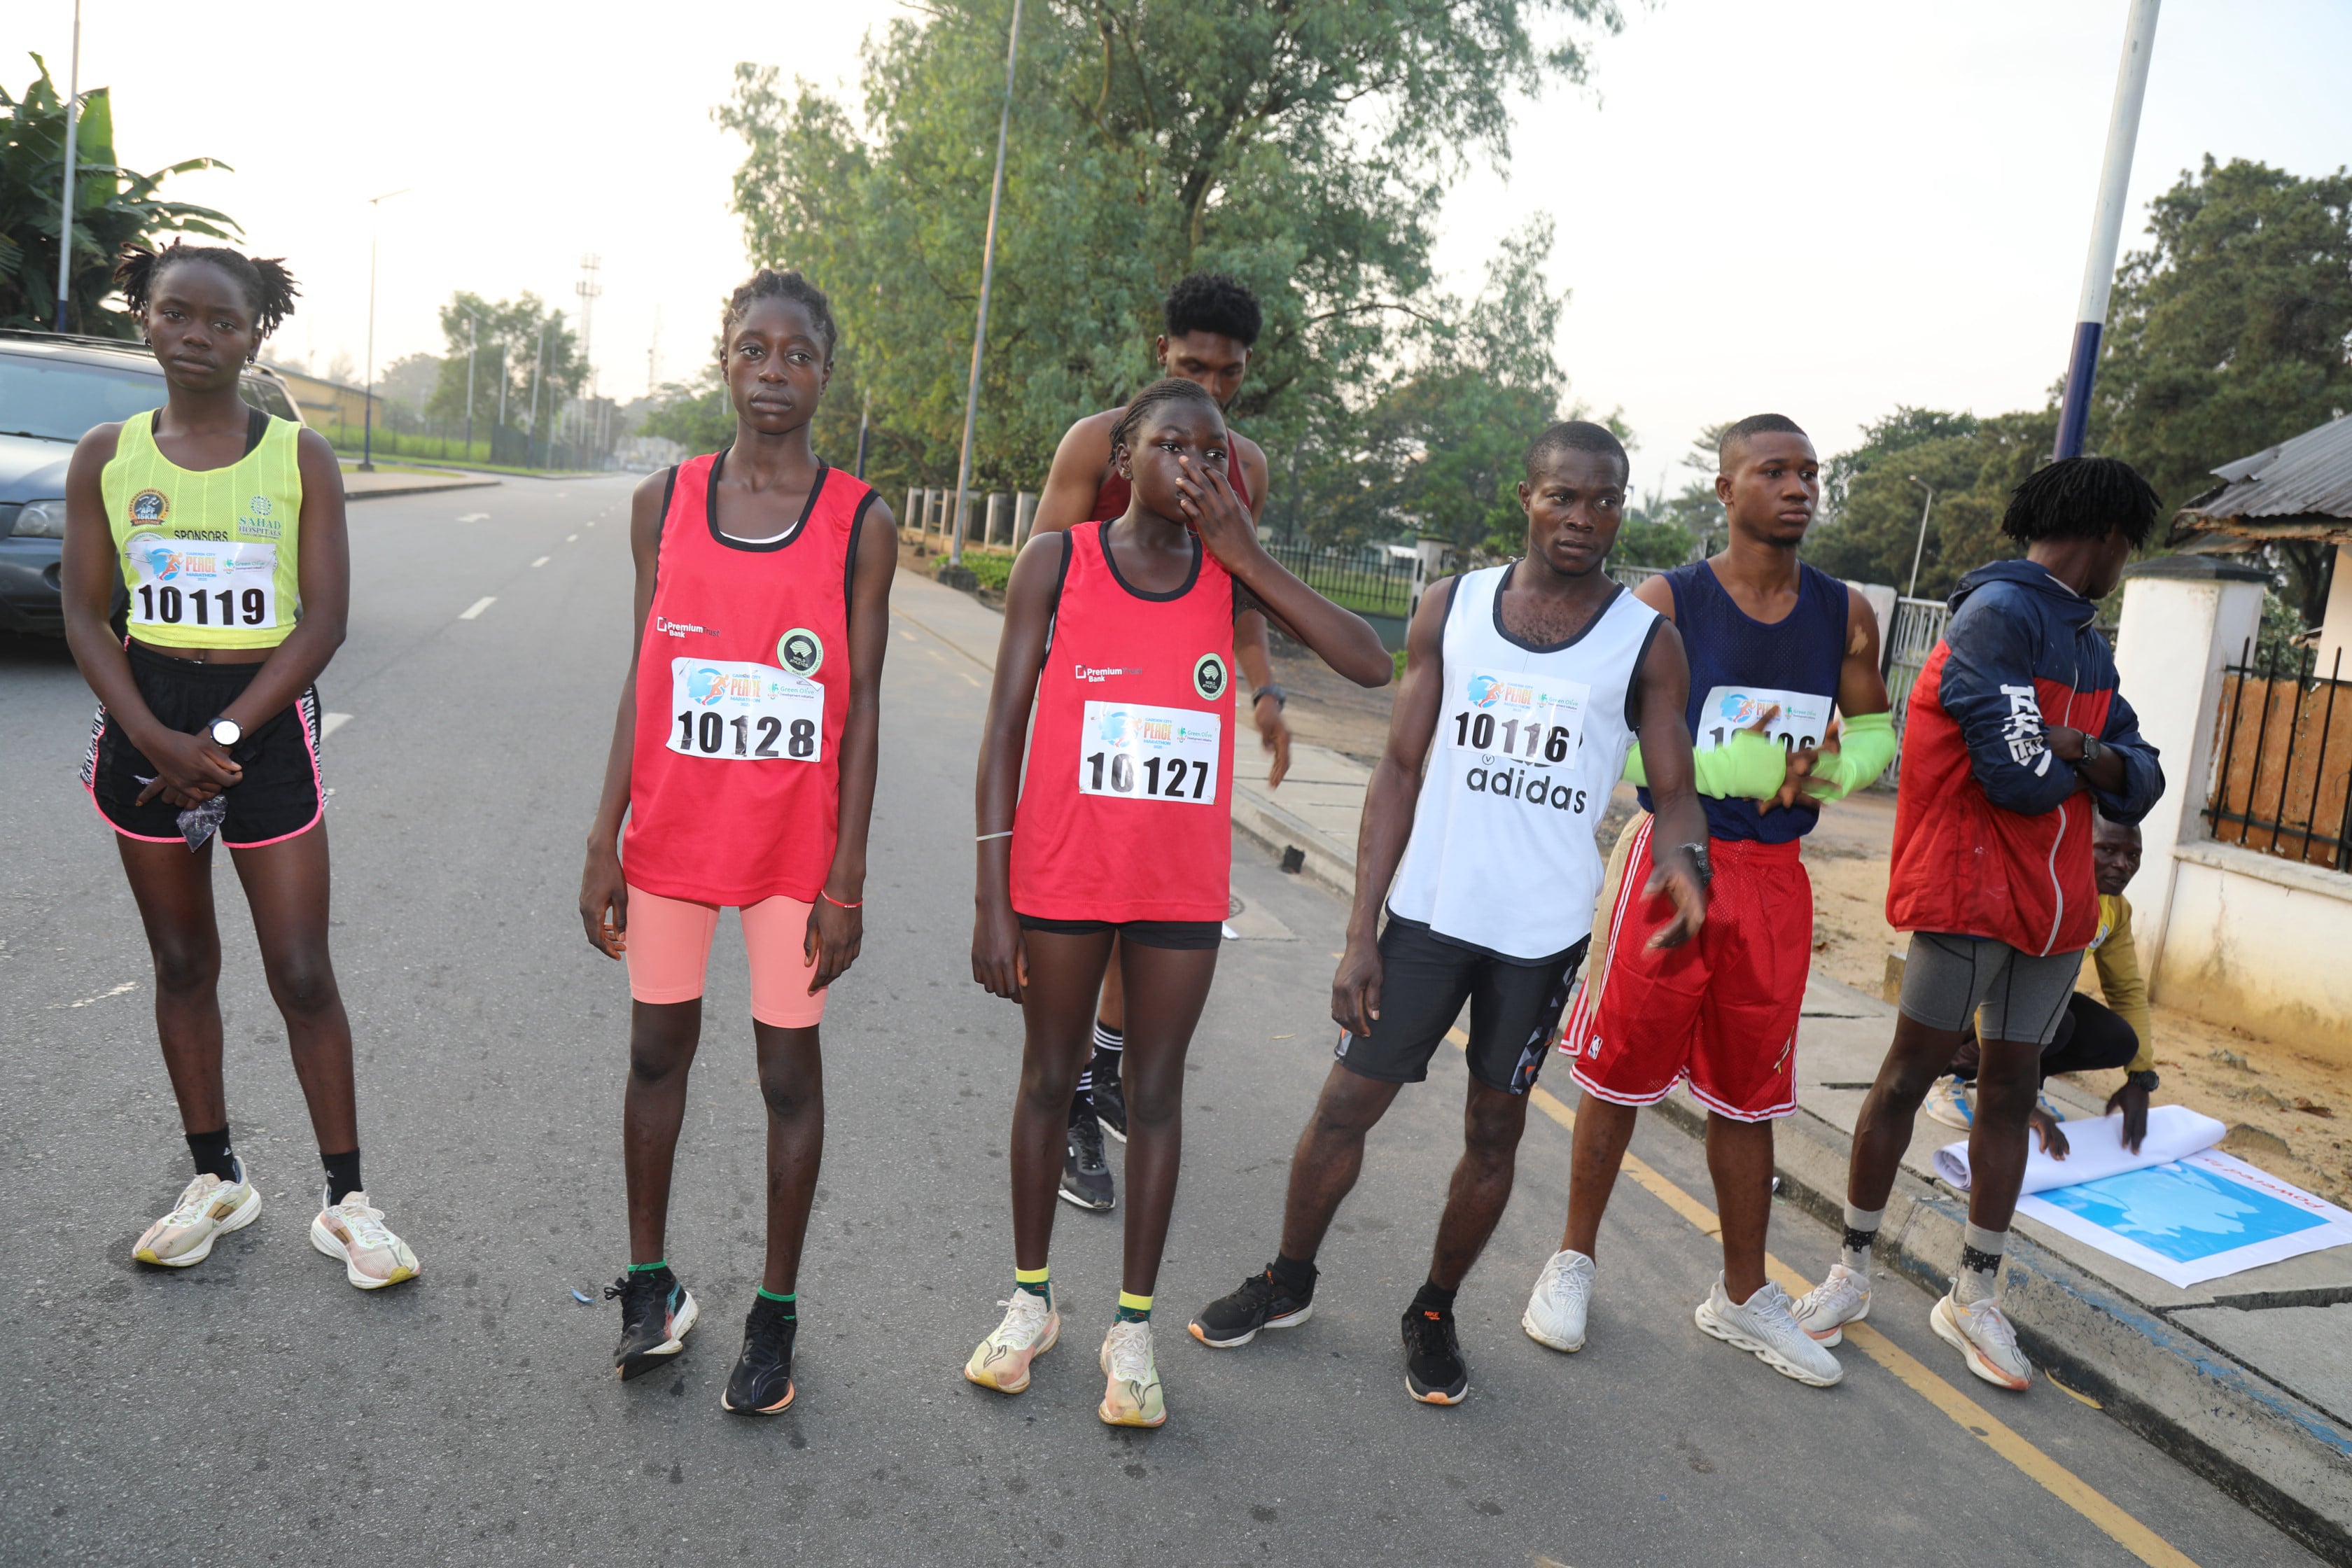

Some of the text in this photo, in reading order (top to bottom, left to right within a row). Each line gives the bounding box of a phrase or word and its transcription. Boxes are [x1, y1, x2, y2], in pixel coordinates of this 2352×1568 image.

[239, 516, 281, 529] SAHAD
[239, 526, 281, 536] HOSPITALS
[174, 530, 228, 542] SPONSORS
[186, 556, 216, 573] PEACE
[138, 584, 265, 626] 10119
[668, 629, 685, 638] Bank
[789, 659, 808, 668] ATHLETICS
[811, 662, 820, 673] LABEL
[731, 678, 761, 698] PEACE
[799, 687, 815, 695] Olive
[1504, 687, 1533, 705] PEACE
[677, 710, 816, 758] 10128
[1143, 722, 1172, 741] PEACE
[1455, 711, 1570, 763] 10116
[1087, 752, 1209, 799] 10127
[1466, 767, 1588, 815] adidas
